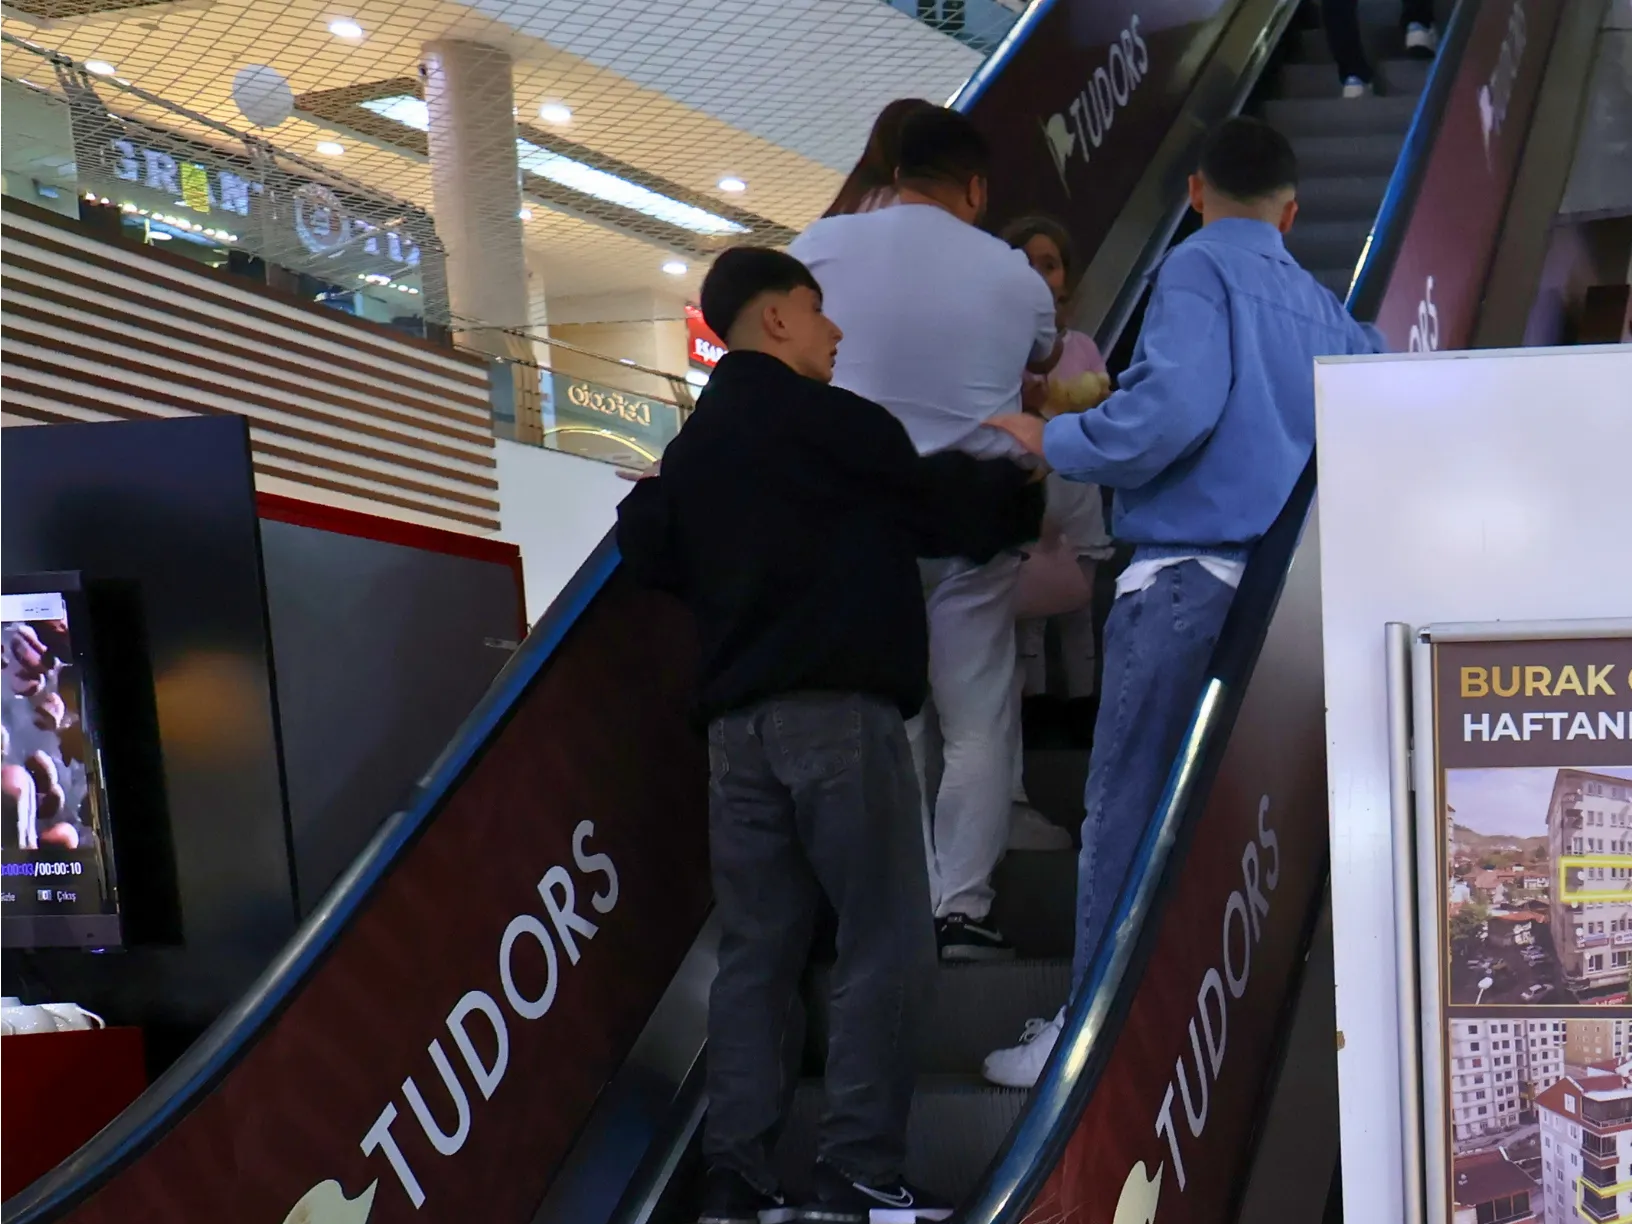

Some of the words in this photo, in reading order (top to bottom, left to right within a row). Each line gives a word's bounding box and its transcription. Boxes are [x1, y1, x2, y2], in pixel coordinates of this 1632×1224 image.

[1069, 14, 1148, 163] TUDORS
[1460, 664, 1616, 698] BURAK
[360, 819, 619, 1210] TUDORS
[1155, 795, 1280, 1193] TUDORS
